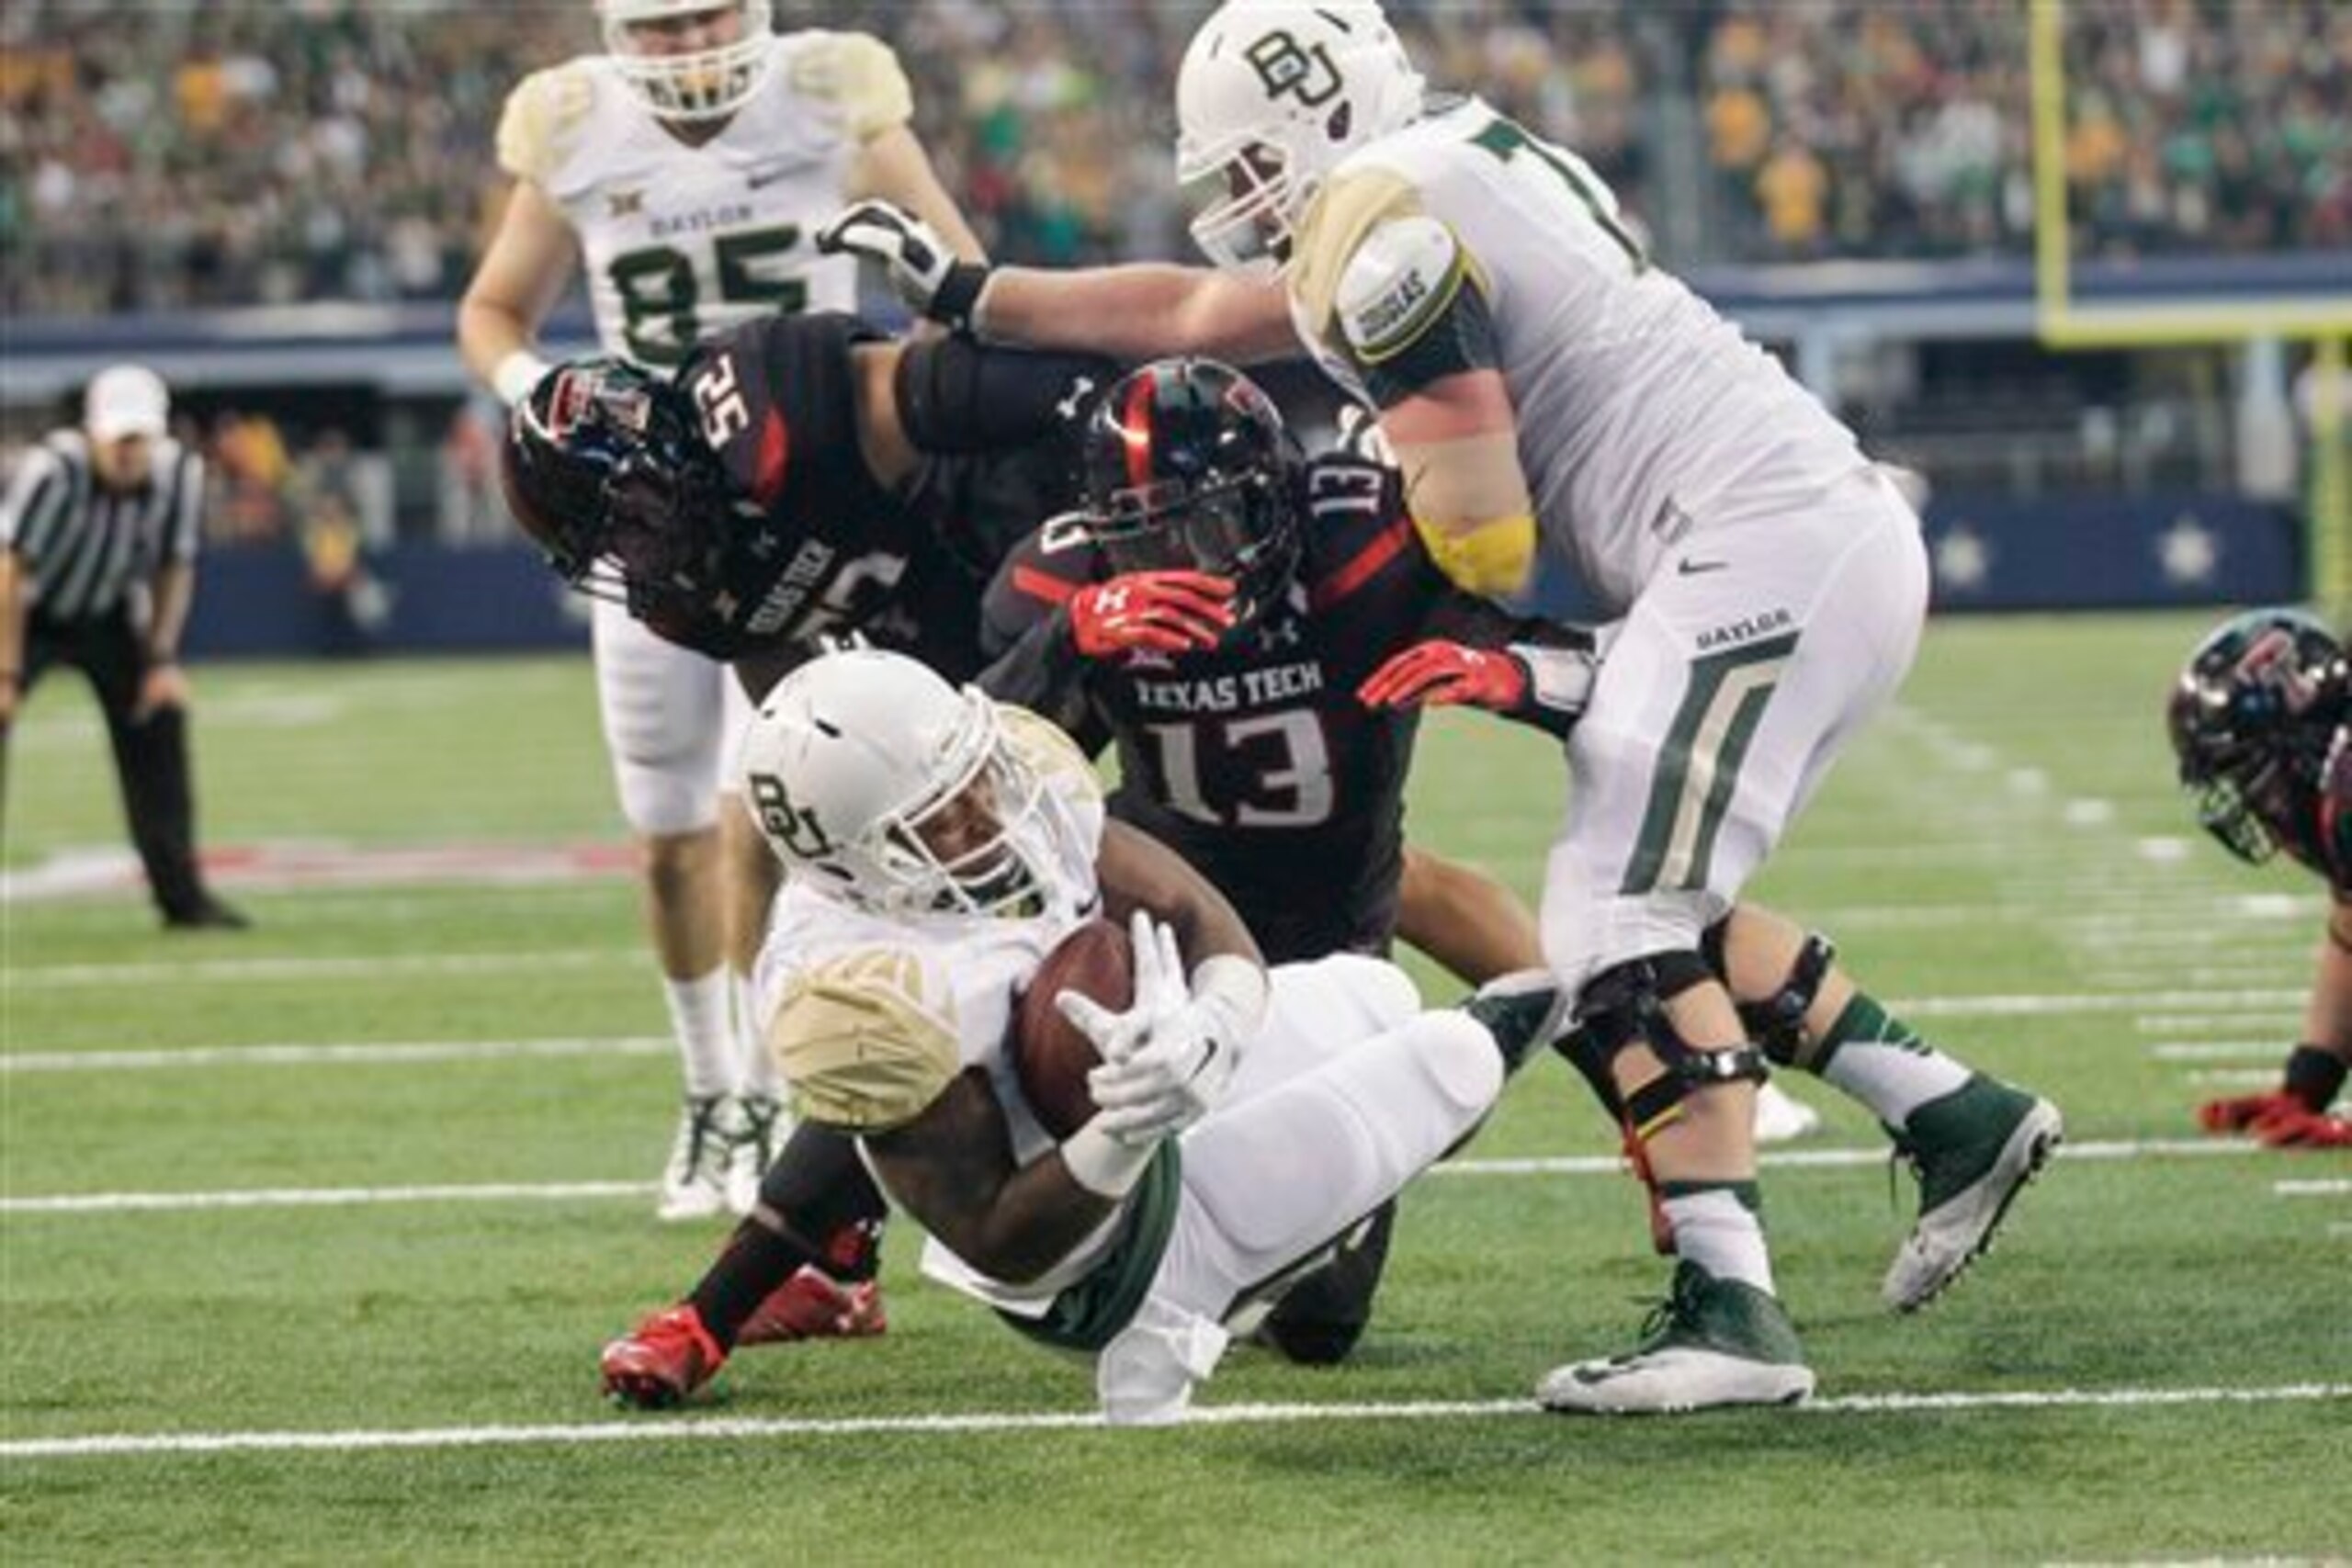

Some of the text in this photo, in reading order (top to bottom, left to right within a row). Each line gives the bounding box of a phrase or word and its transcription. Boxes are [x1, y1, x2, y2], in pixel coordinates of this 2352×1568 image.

[1243, 28, 1342, 107] BU
[608, 225, 808, 367] 85
[693, 353, 749, 450] 25
[1309, 467, 1380, 517] 13
[1134, 660, 1324, 711] TEXAS TECH
[1144, 708, 1335, 826] 13
[748, 773, 832, 859] BU
